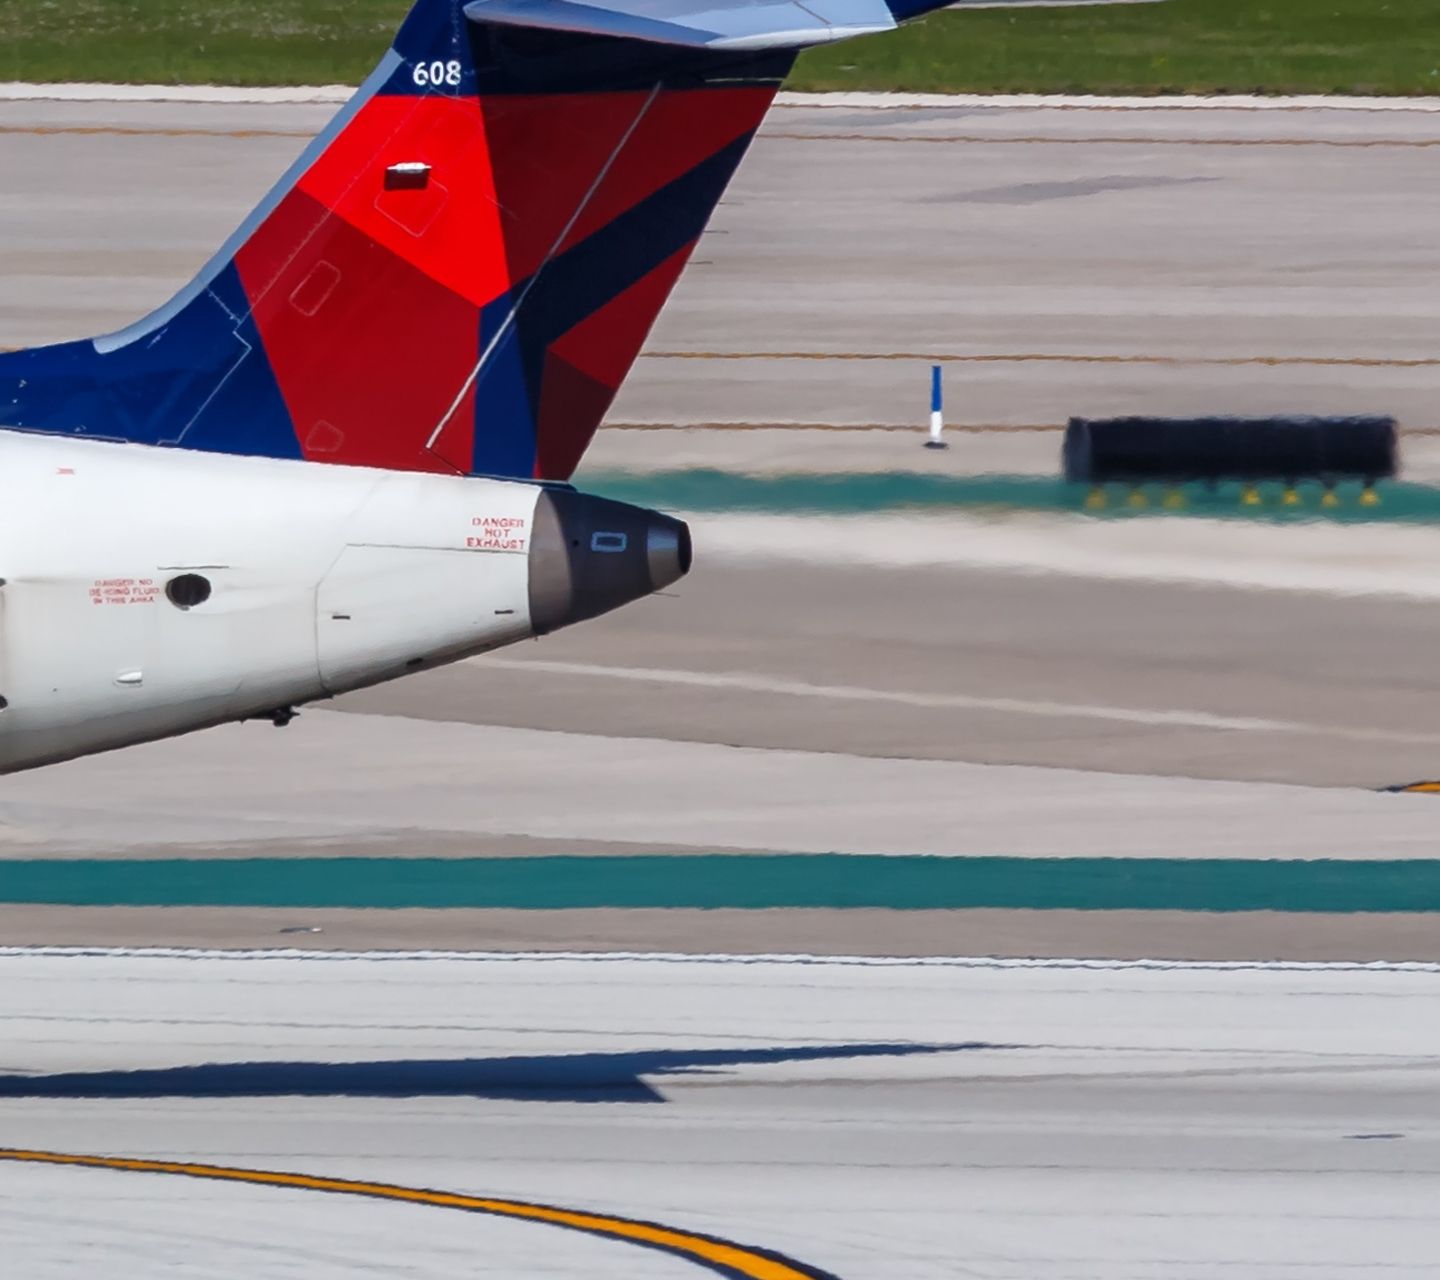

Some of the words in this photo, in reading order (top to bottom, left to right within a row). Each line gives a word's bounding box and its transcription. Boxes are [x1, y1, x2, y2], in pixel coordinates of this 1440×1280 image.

[413, 60, 461, 86] 608
[472, 517, 524, 527] DANGER
[484, 528, 511, 537] HOT
[466, 537, 525, 549] EXHAUST
